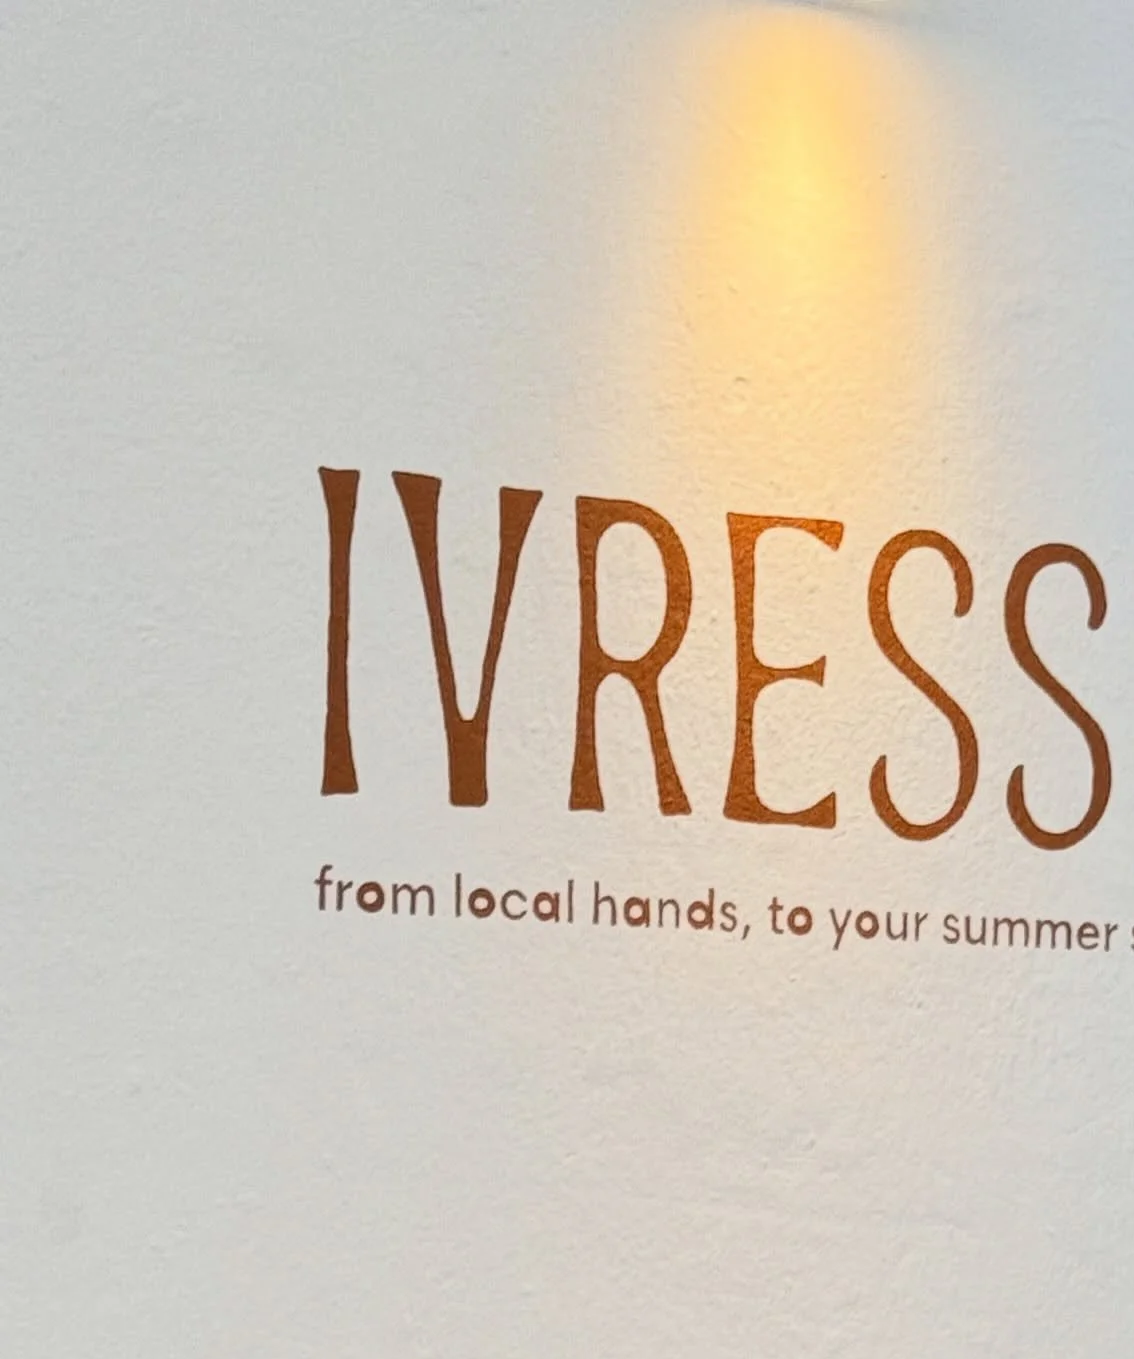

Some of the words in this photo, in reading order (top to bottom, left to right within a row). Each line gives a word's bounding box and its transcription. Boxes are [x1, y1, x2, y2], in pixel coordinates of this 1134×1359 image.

[313, 863, 435, 917] from
[454, 872, 575, 924] local
[591, 880, 751, 941] hands,
[767, 896, 814, 937] to
[828, 906, 929, 951] your
[942, 912, 1119, 953] summer
